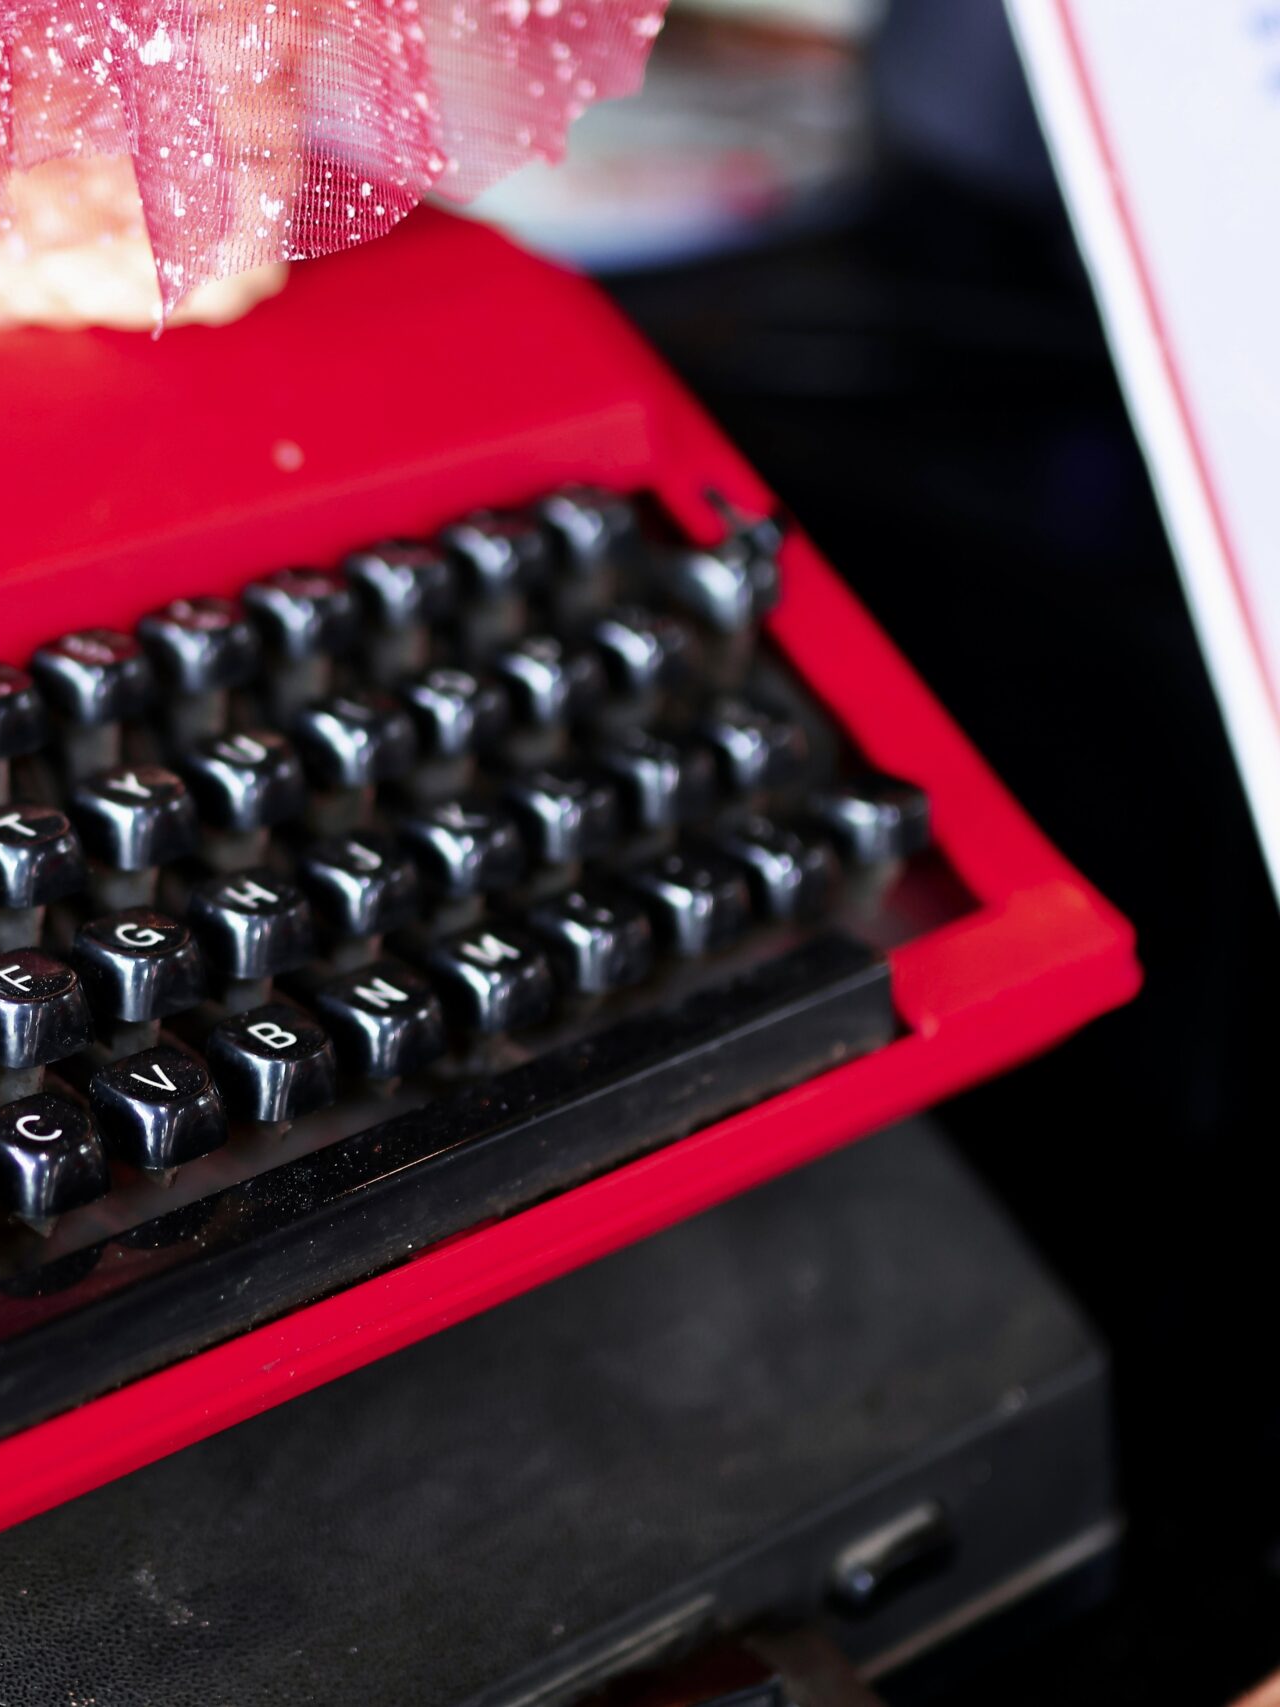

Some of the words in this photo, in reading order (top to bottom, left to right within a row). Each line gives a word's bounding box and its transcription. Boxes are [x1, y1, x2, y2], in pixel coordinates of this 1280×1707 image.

[214, 734, 268, 764] U
[109, 773, 152, 799] Y
[224, 880, 279, 909] H
[115, 923, 166, 948] G
[460, 933, 521, 967] M
[354, 978, 409, 1009] N
[247, 1022, 298, 1049] B
[130, 1064, 178, 1092] V
[16, 1115, 62, 1142] C
